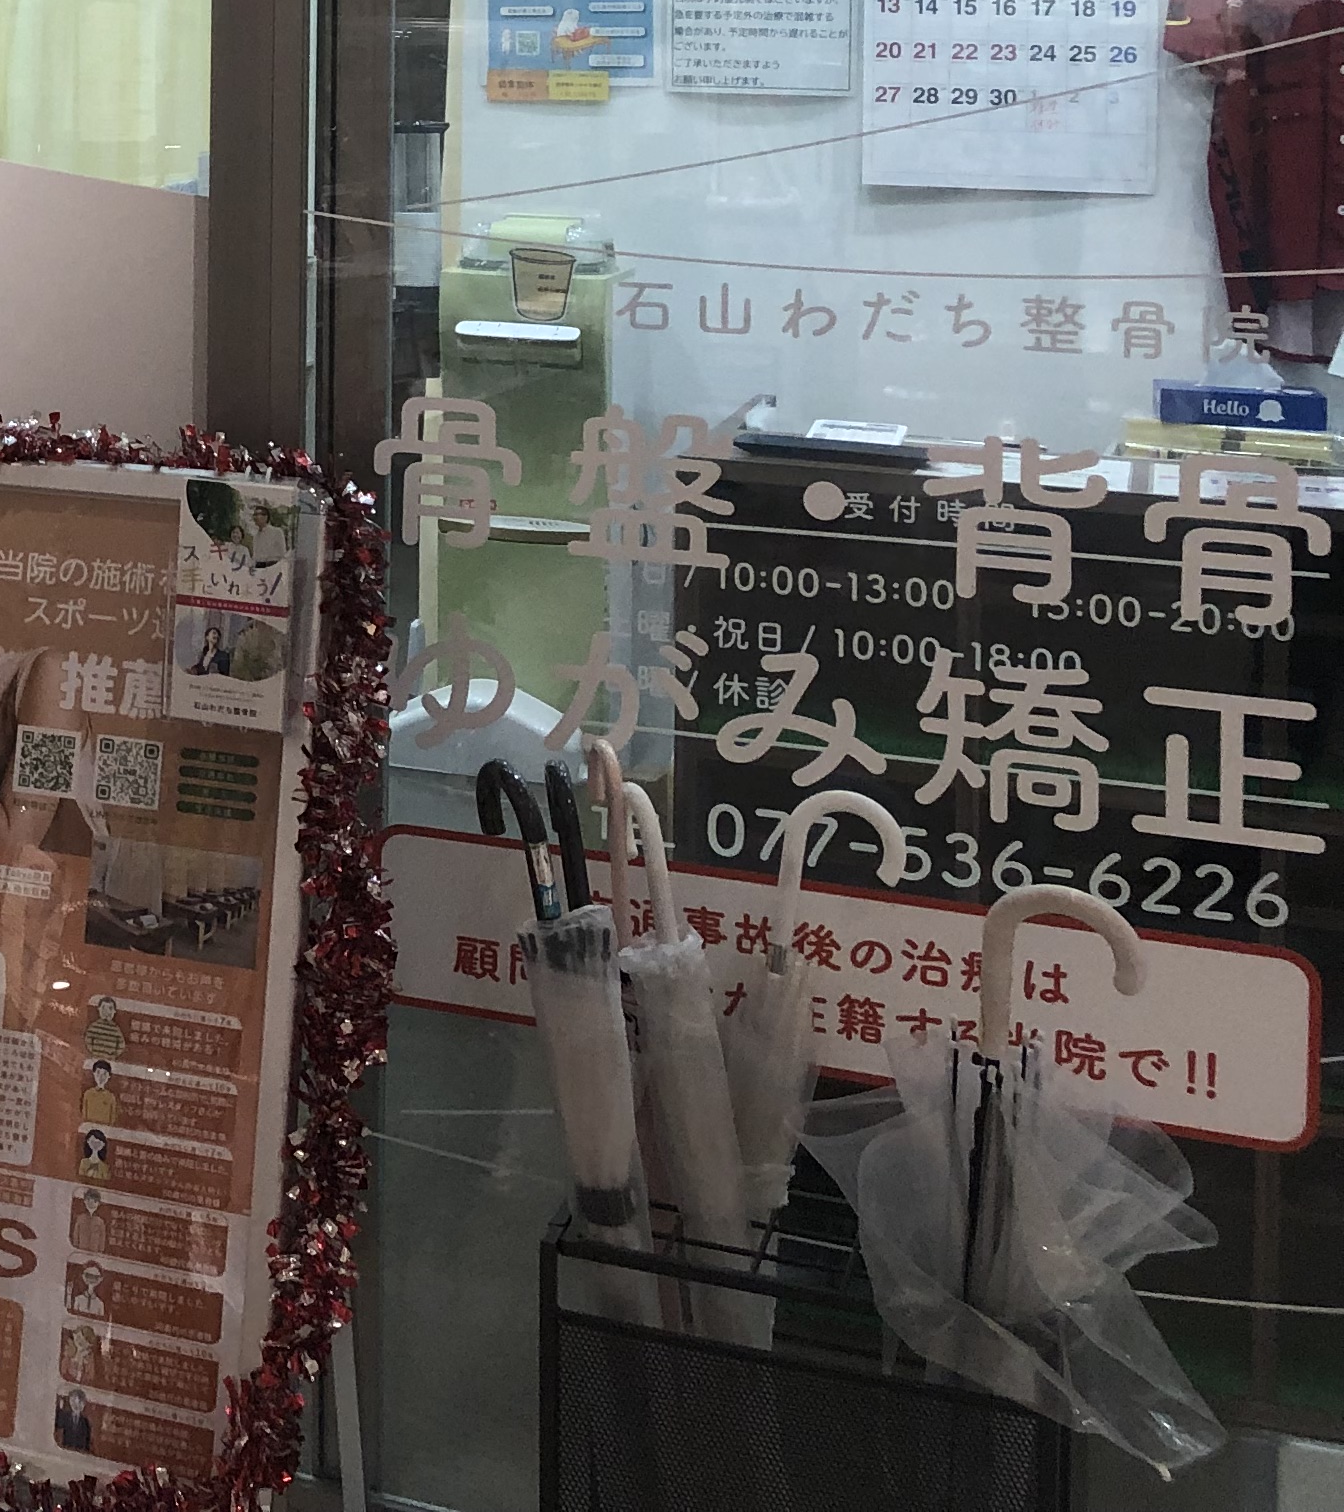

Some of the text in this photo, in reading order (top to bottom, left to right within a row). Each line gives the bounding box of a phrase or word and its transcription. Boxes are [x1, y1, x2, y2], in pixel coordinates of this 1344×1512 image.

[953, 0, 977, 15] 15
[992, 0, 1016, 15] 16
[1031, 0, 1056, 16] 17
[1071, 0, 1096, 17] 18
[1111, 0, 1136, 17] 19
[875, 42, 1137, 63] 20 21 22 23 24 25 26
[875, 86, 901, 103] 27
[913, 87, 939, 104] 28
[951, 88, 978, 105] 29
[989, 88, 1016, 105] 30
[615, 282, 1273, 364] 石山わだち整骨院
[1203, 399, 1250, 416] Hello
[373, 396, 1332, 626] 骨盤・背骨
[389, 611, 1327, 856] ゆがみ矯正
